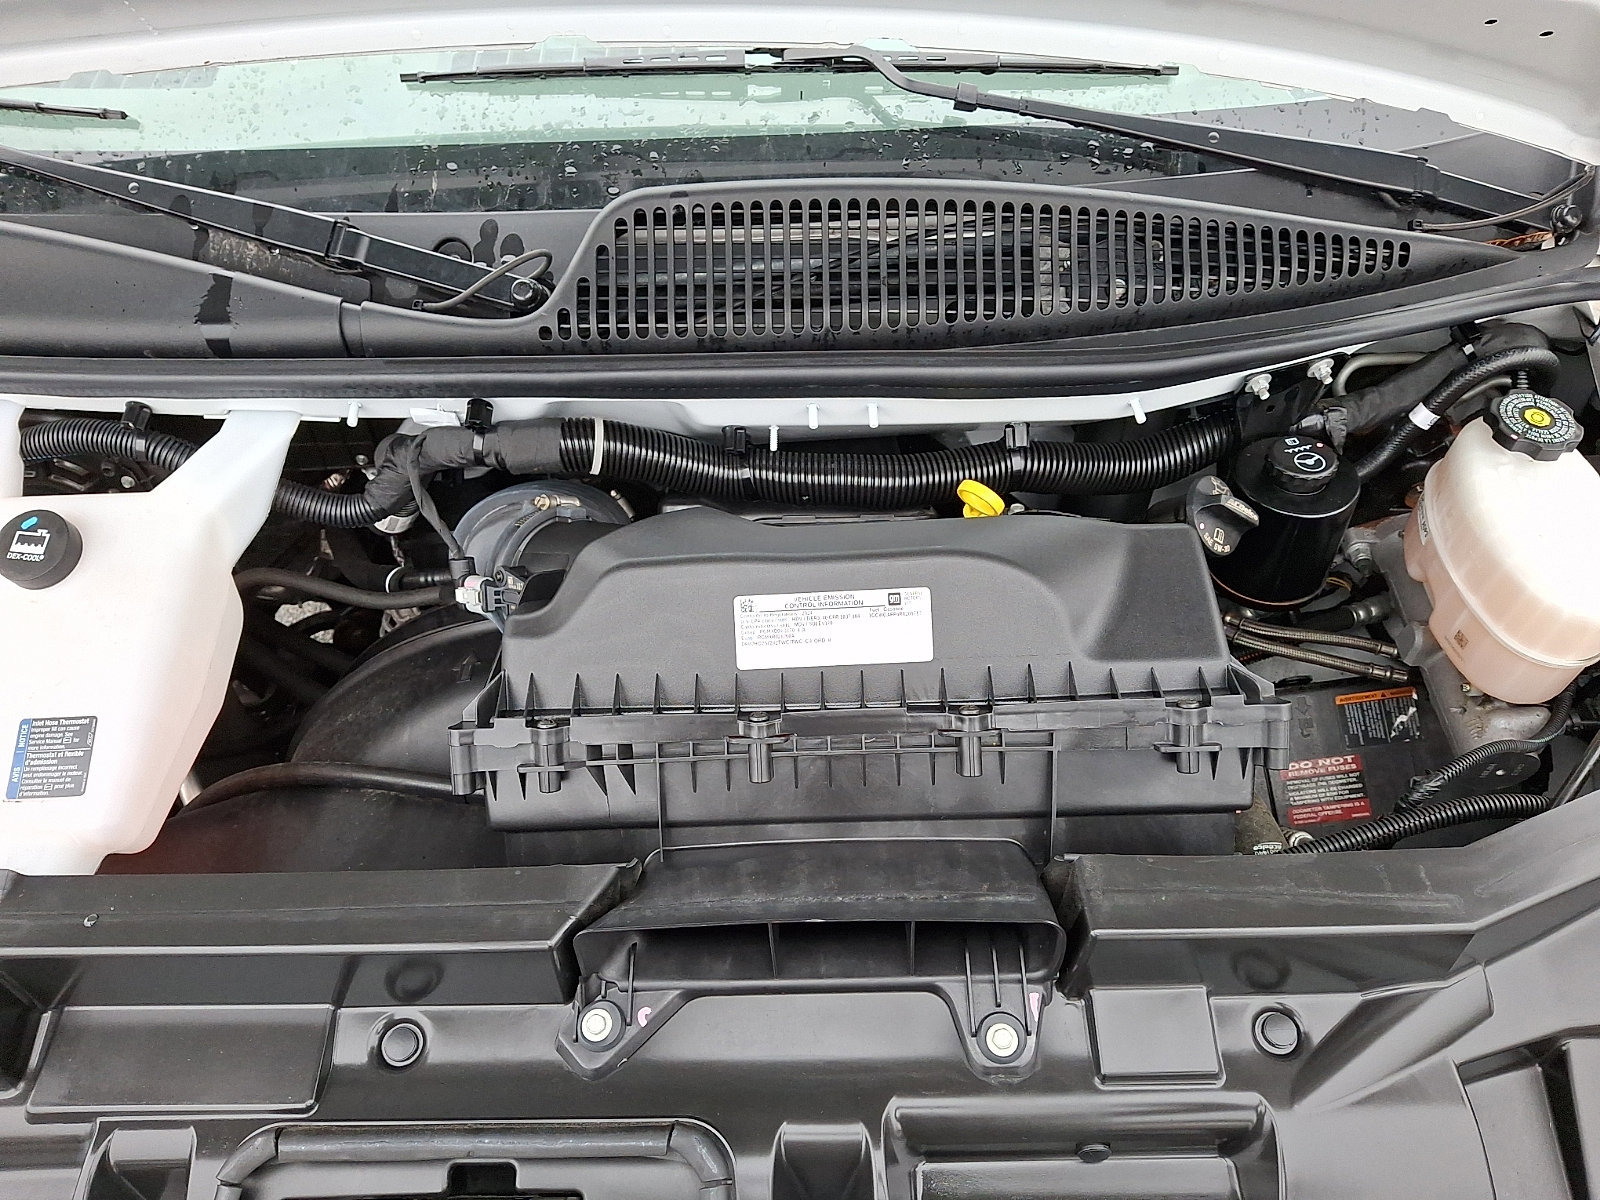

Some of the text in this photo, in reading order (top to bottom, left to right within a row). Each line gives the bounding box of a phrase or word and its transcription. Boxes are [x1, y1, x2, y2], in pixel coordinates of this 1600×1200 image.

[60, 718, 90, 726] Thermostat
[18, 724, 28, 748] NOTICE
[1289, 755, 1355, 770] DO NOT
[12, 766, 20, 782] AVIS
[1288, 764, 1357, 777] REMOVE FUSES
